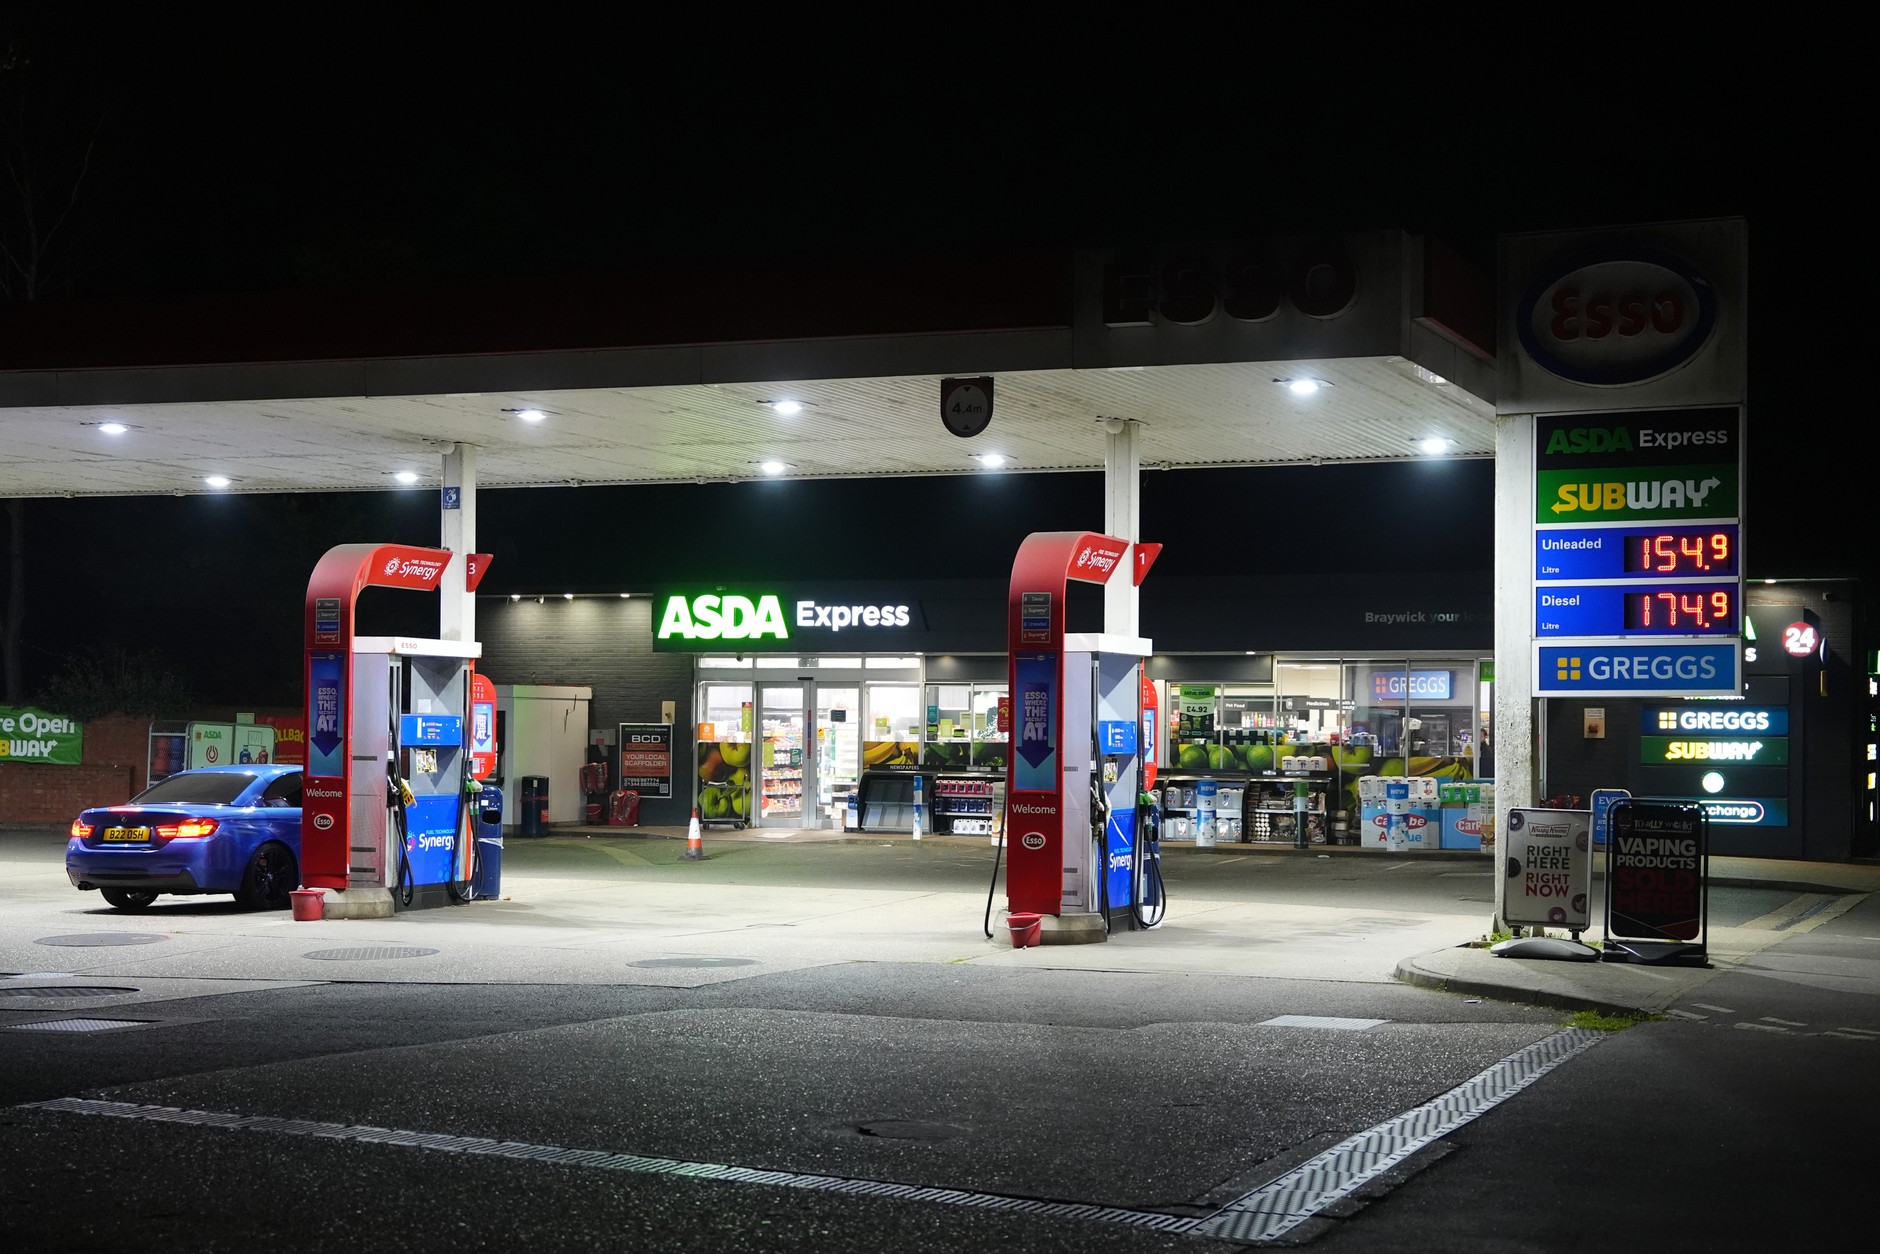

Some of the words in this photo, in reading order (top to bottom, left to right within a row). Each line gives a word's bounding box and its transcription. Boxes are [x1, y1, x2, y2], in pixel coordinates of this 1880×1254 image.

[1551, 288, 1684, 341] Esso
[952, 402, 982, 415] 4.4m
[1546, 427, 1633, 454] ASDA
[1639, 429, 1728, 449] Express
[1552, 478, 1720, 513] SUBWAY
[1139, 552, 1145, 564] 1
[1542, 538, 1602, 550] Unleaded
[1642, 534, 1727, 571] 154.9
[468, 562, 476, 574] 3
[1087, 552, 1116, 572] Synergy
[399, 562, 439, 580] Synergy
[1542, 566, 1560, 574] Litre
[658, 594, 788, 639] ASDA
[796, 601, 910, 632] Express
[1542, 595, 1580, 607] Diesel
[1642, 592, 1727, 628] 174.9
[1365, 612, 1426, 624] Braywick
[1430, 613, 1460, 624] your
[1542, 622, 1560, 630] Litre
[1786, 627, 1816, 648] 24
[1588, 656, 1716, 680] GREGGS
[1389, 677, 1446, 693] GREGGS
[318, 700, 336, 710] THE
[1025, 706, 1046, 717] THE
[19, 712, 74, 738] Open
[1680, 712, 1770, 730] GREGGS
[204, 731, 222, 740] ASDA
[632, 734, 661, 742] BCD
[1024, 722, 1048, 740] AT.
[1665, 741, 1763, 760] SUBWAY
[306, 788, 342, 798] Welcome
[1012, 804, 1056, 814] Welcome
[316, 818, 330, 826] Esso
[1375, 816, 1424, 826] Cabe
[110, 830, 126, 840] B22
[1378, 831, 1422, 842] Aue
[1532, 826, 1550, 834] Krispy
[1550, 826, 1567, 834] Kreme
[418, 834, 454, 852] Synergy
[1024, 836, 1042, 845] Esso
[1618, 836, 1696, 856] VAPING
[1527, 846, 1571, 857] RIGHT
[1110, 852, 1132, 872] Synergy
[1526, 856, 1570, 870] HERE
[1616, 854, 1696, 870] PRODUCTS
[1526, 872, 1570, 884] RIGHT
[1616, 868, 1696, 892] SOLD
[1526, 884, 1570, 898] NOW
